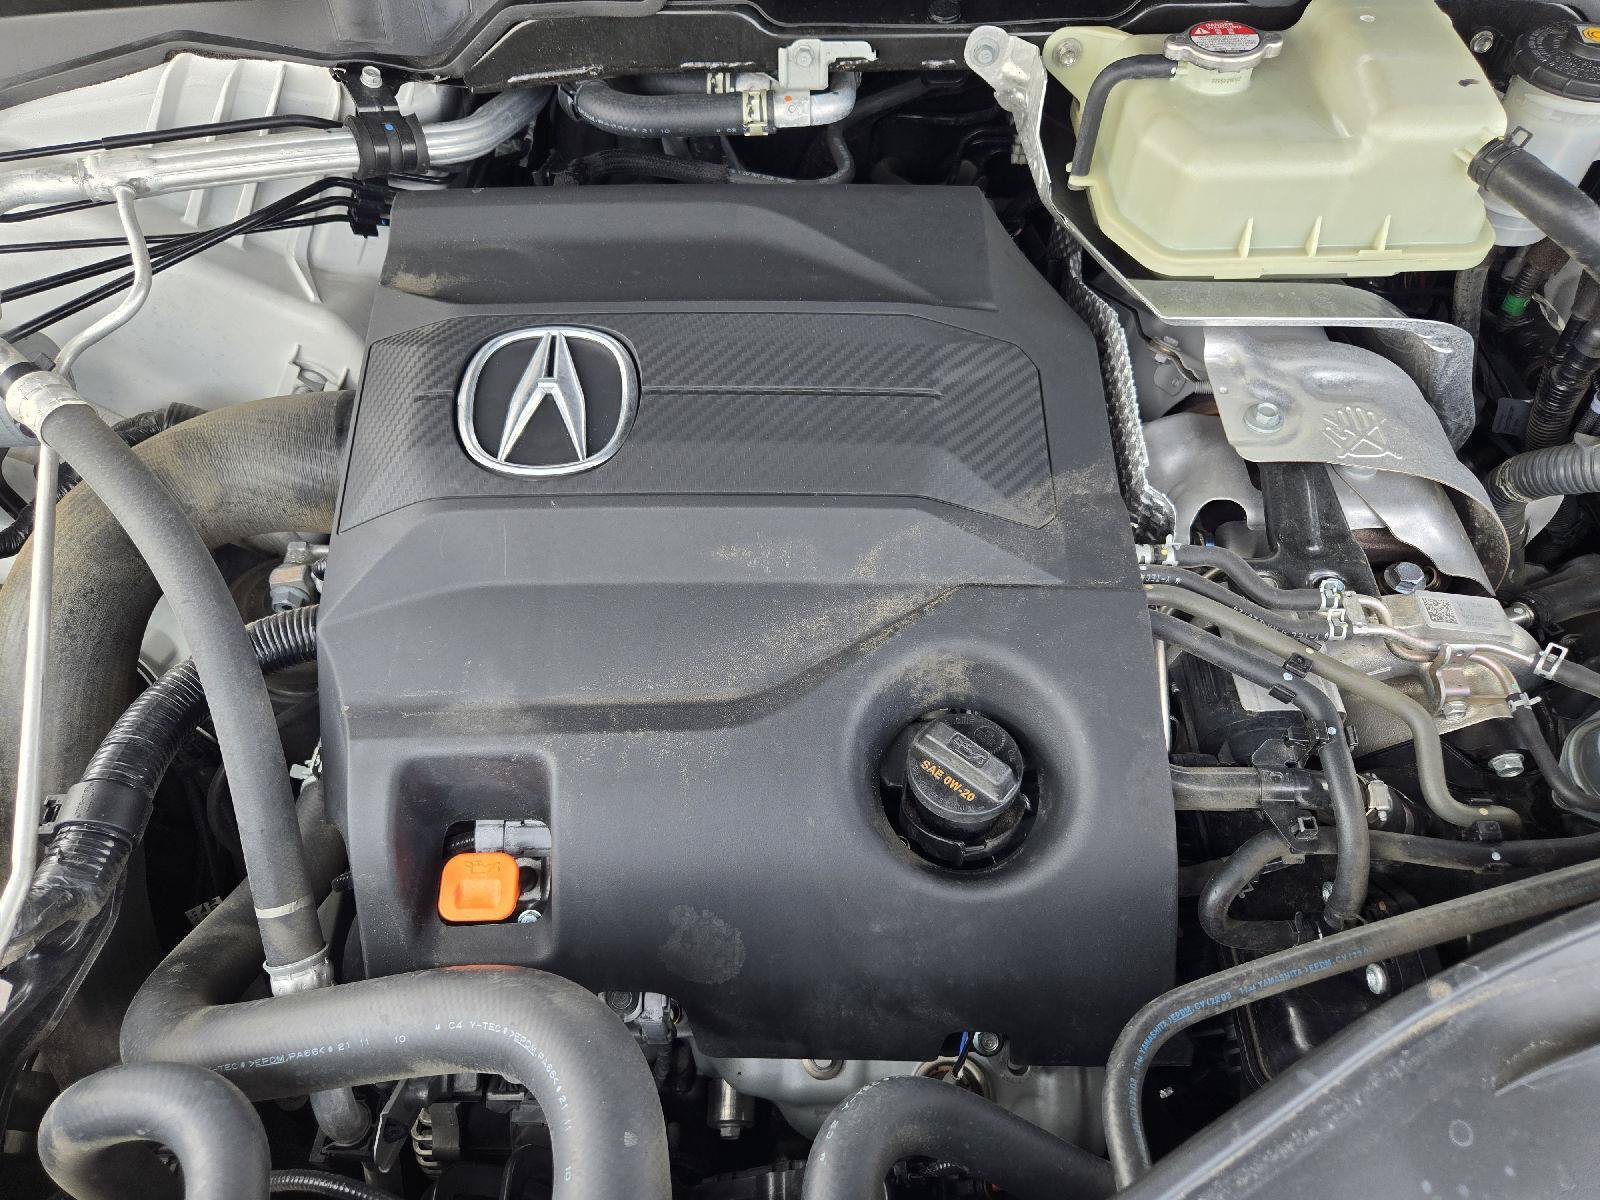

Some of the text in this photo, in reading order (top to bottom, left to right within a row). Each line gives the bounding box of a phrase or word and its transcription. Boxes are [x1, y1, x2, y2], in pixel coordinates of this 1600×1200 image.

[921, 760, 976, 802] SAE 0W-20
[1138, 1020, 1169, 1055] YAMASHITA
[1258, 968, 1304, 990] YAMASHITA
